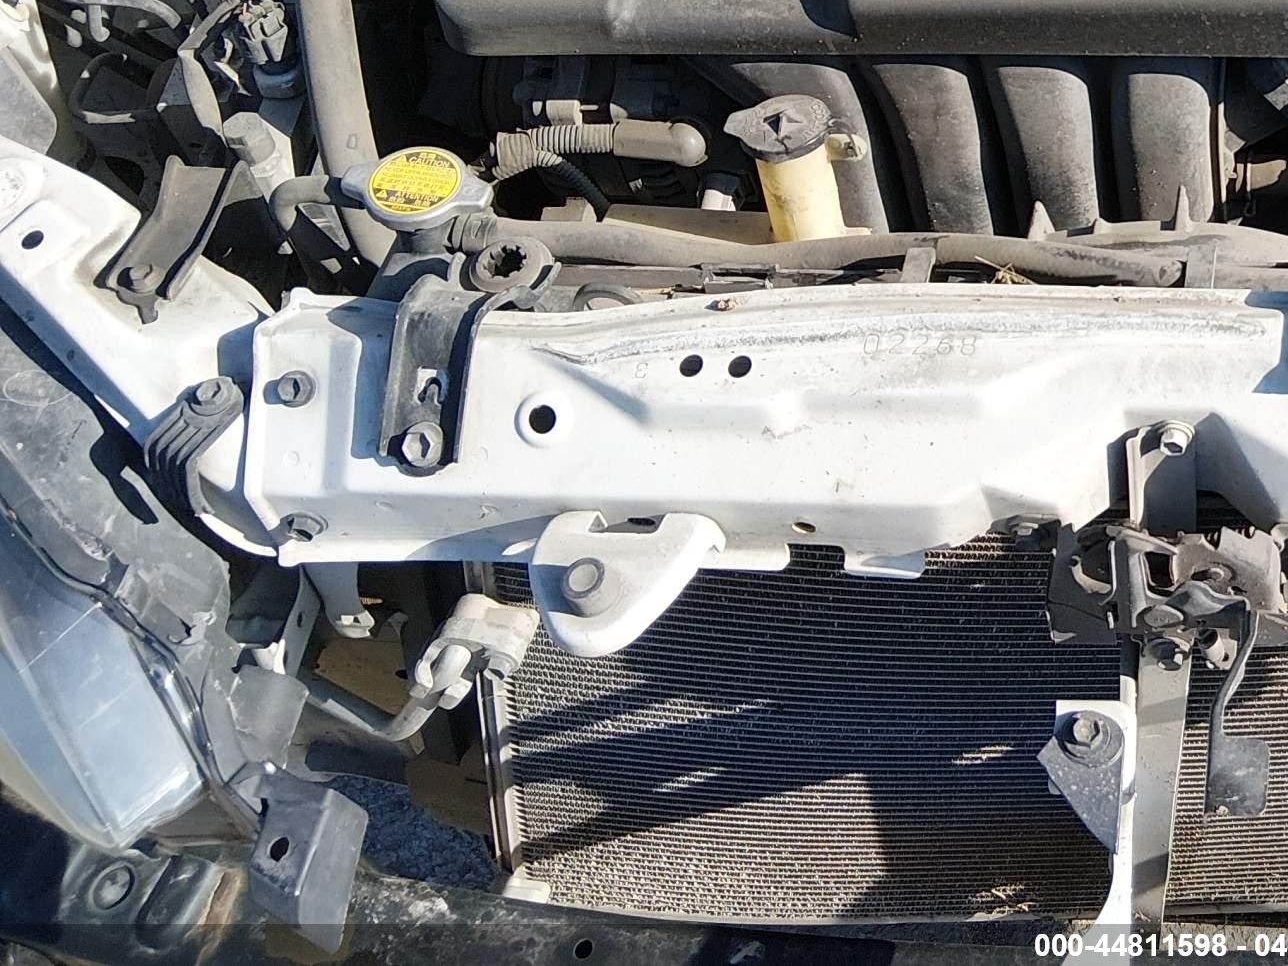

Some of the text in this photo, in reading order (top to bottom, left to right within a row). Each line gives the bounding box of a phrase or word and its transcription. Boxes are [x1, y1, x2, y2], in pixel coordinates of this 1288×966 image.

[409, 156, 450, 168] CAUTION
[395, 191, 439, 203] ATTENTION
[863, 333, 976, 355] 02268
